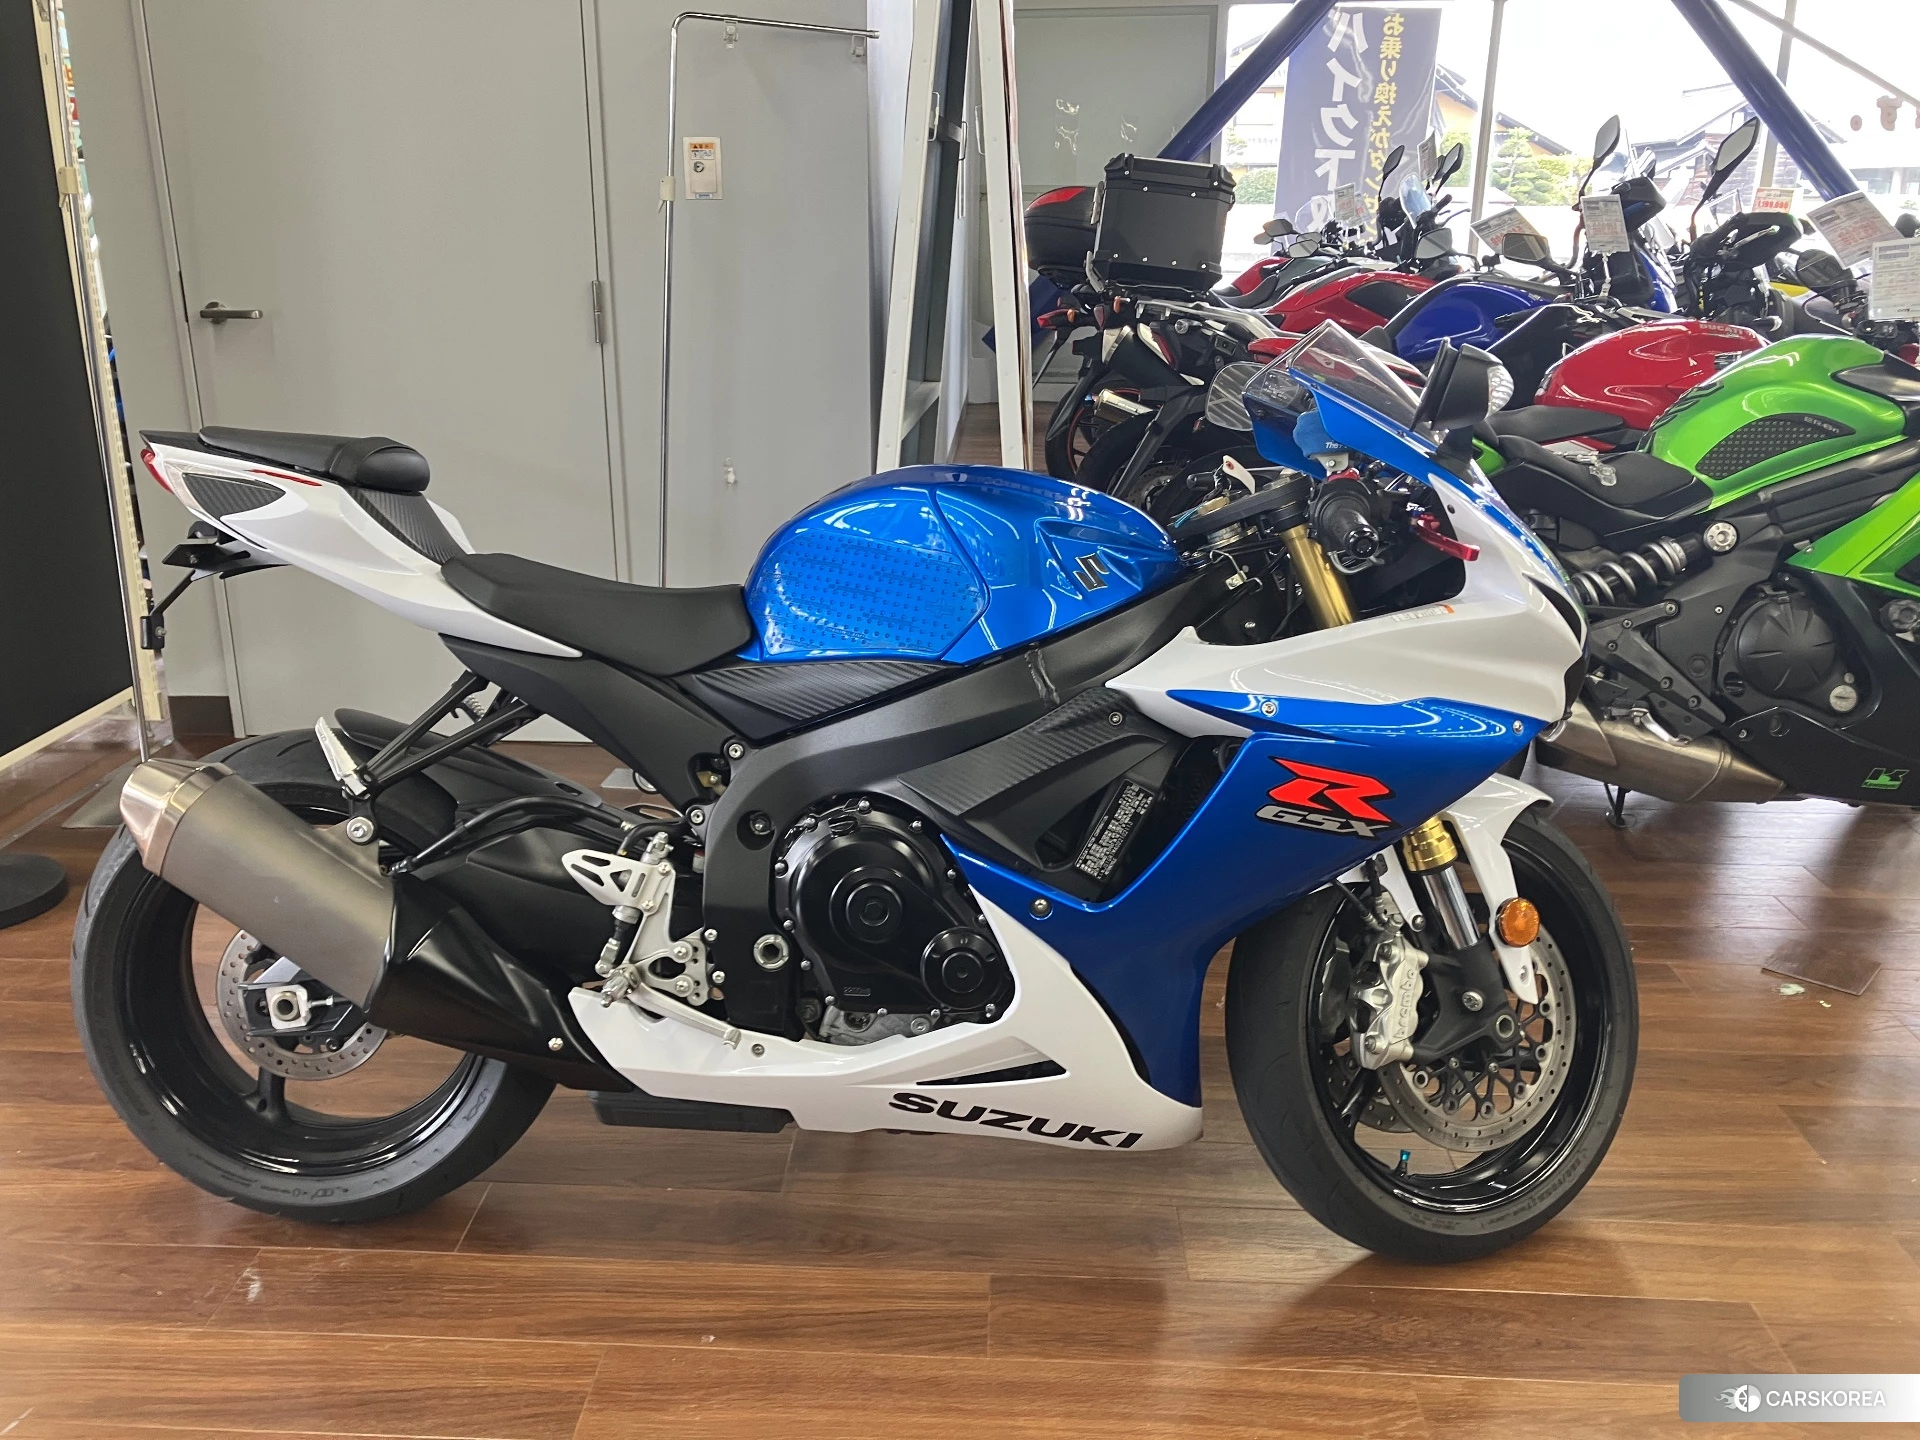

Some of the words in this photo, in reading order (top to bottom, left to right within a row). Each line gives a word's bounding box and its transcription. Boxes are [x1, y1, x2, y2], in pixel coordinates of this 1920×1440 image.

[1699, 323, 1743, 334] DUCATI
[1268, 757, 1392, 822] R
[1255, 805, 1390, 838] GSX
[1393, 968, 1416, 1039] brembo
[889, 1092, 1143, 1149] SUZUKI
